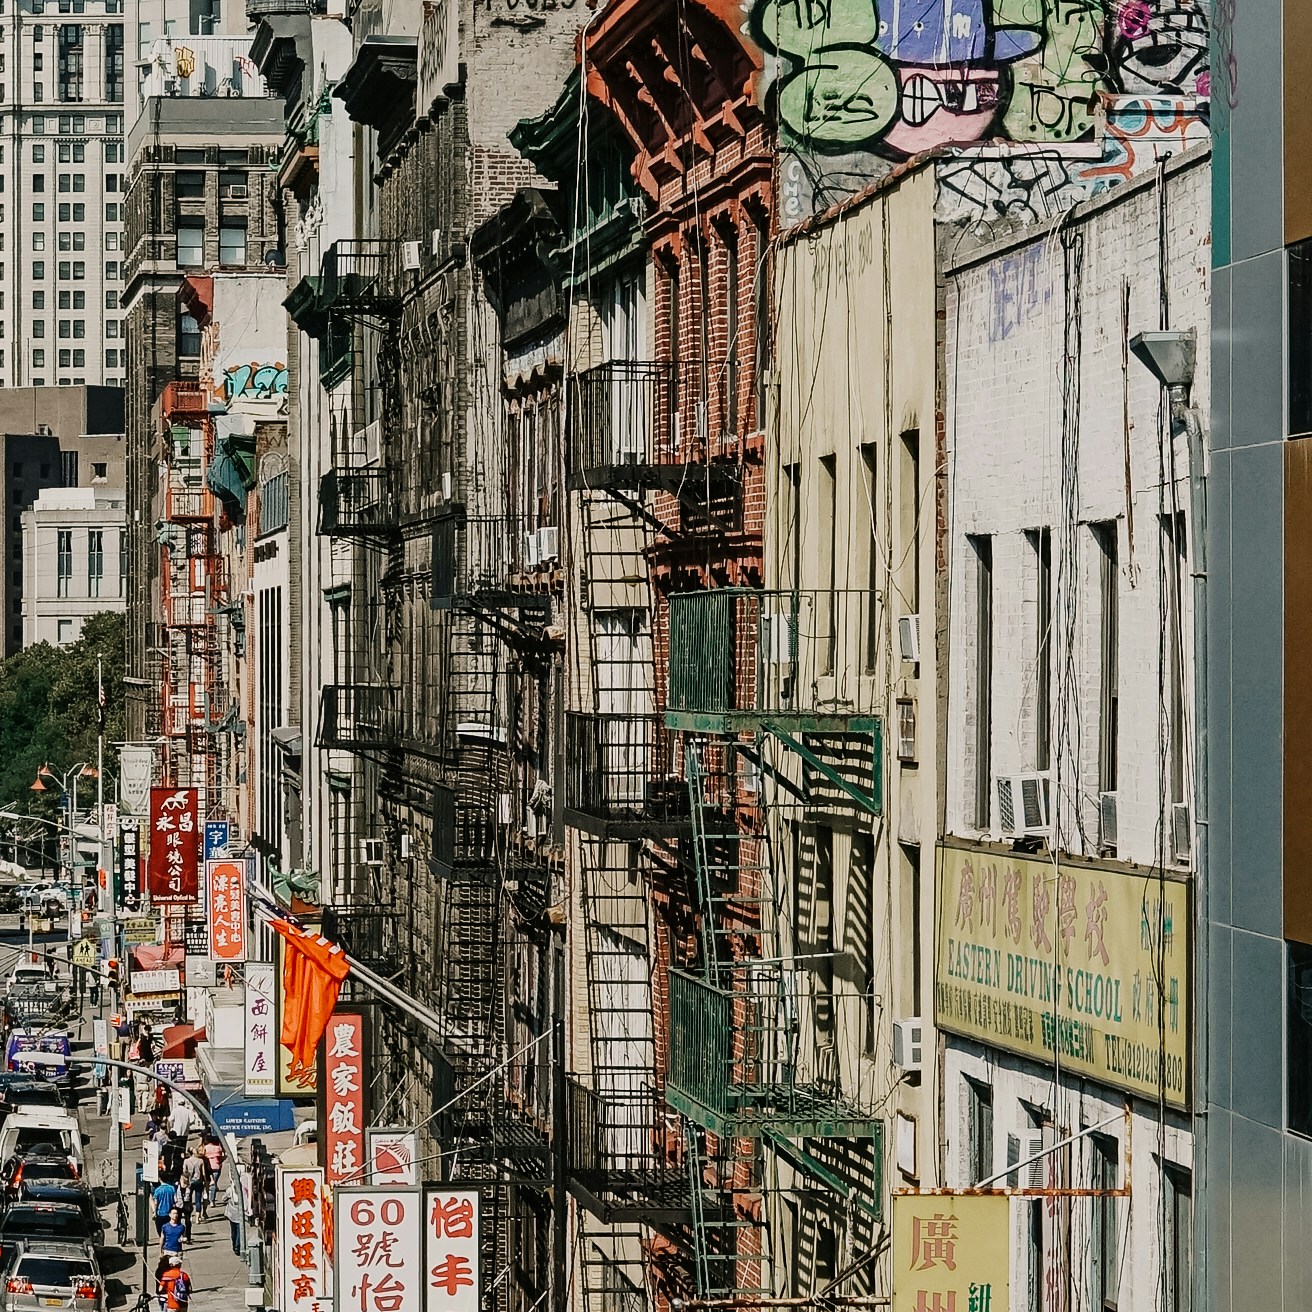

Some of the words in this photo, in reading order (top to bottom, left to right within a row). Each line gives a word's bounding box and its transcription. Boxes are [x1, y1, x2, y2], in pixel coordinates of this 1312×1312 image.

[156, 812, 194, 832] 永昌
[166, 833, 184, 892] 眼鏡公司
[955, 859, 1110, 966] 廣州駕駛學校
[948, 939, 1001, 988] EASTERN
[1007, 953, 1062, 1005] DRIVING
[1067, 966, 1123, 1022] SCHOOL
[1132, 969, 1179, 1034] 政府冊
[250, 998, 269, 1072] 西餅屋
[328, 1023, 362, 1177] 農家飯莊
